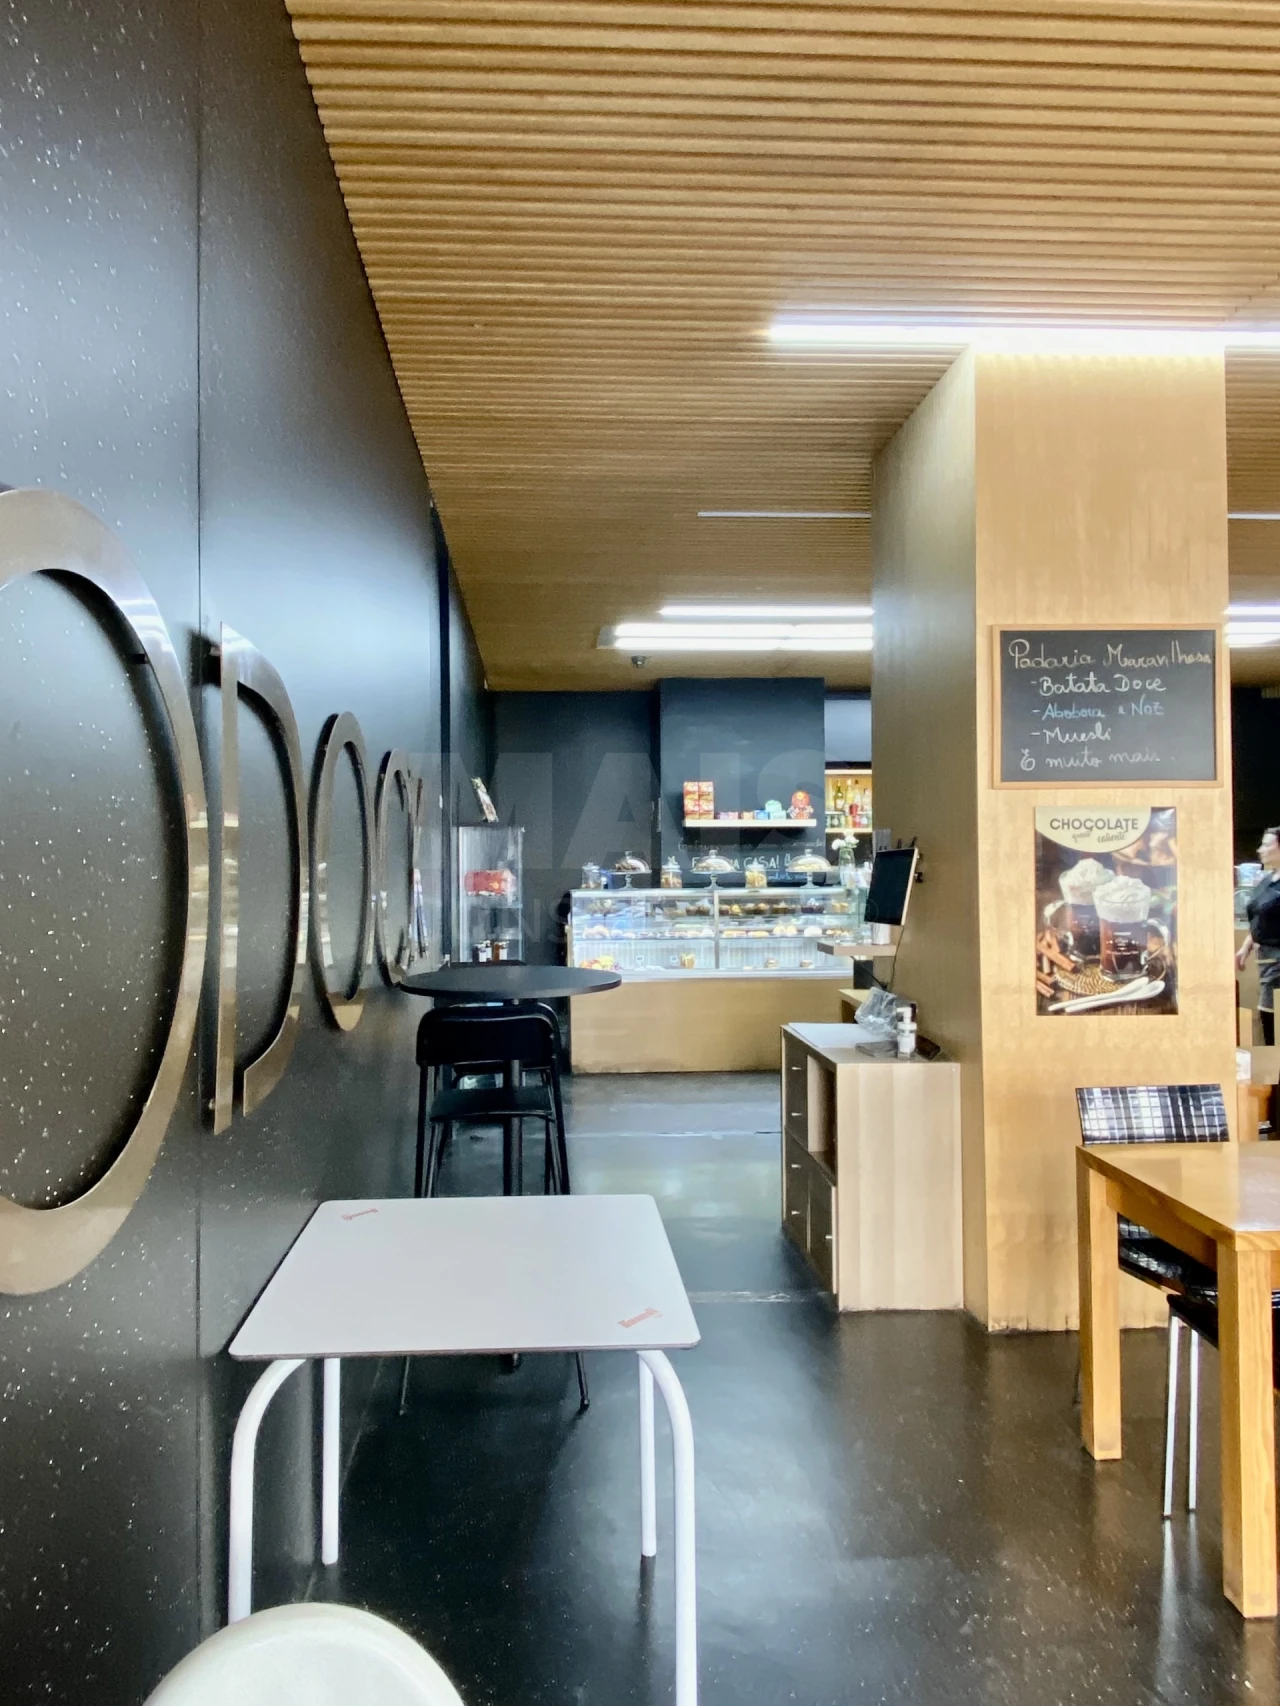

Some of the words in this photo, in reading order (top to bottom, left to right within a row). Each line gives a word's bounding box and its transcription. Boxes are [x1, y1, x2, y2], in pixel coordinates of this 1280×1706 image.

[1008, 638, 1095, 669] Padaria
[1102, 640, 1212, 668] Maravilhosa
[1049, 818, 1139, 832] CHOCOLATE
